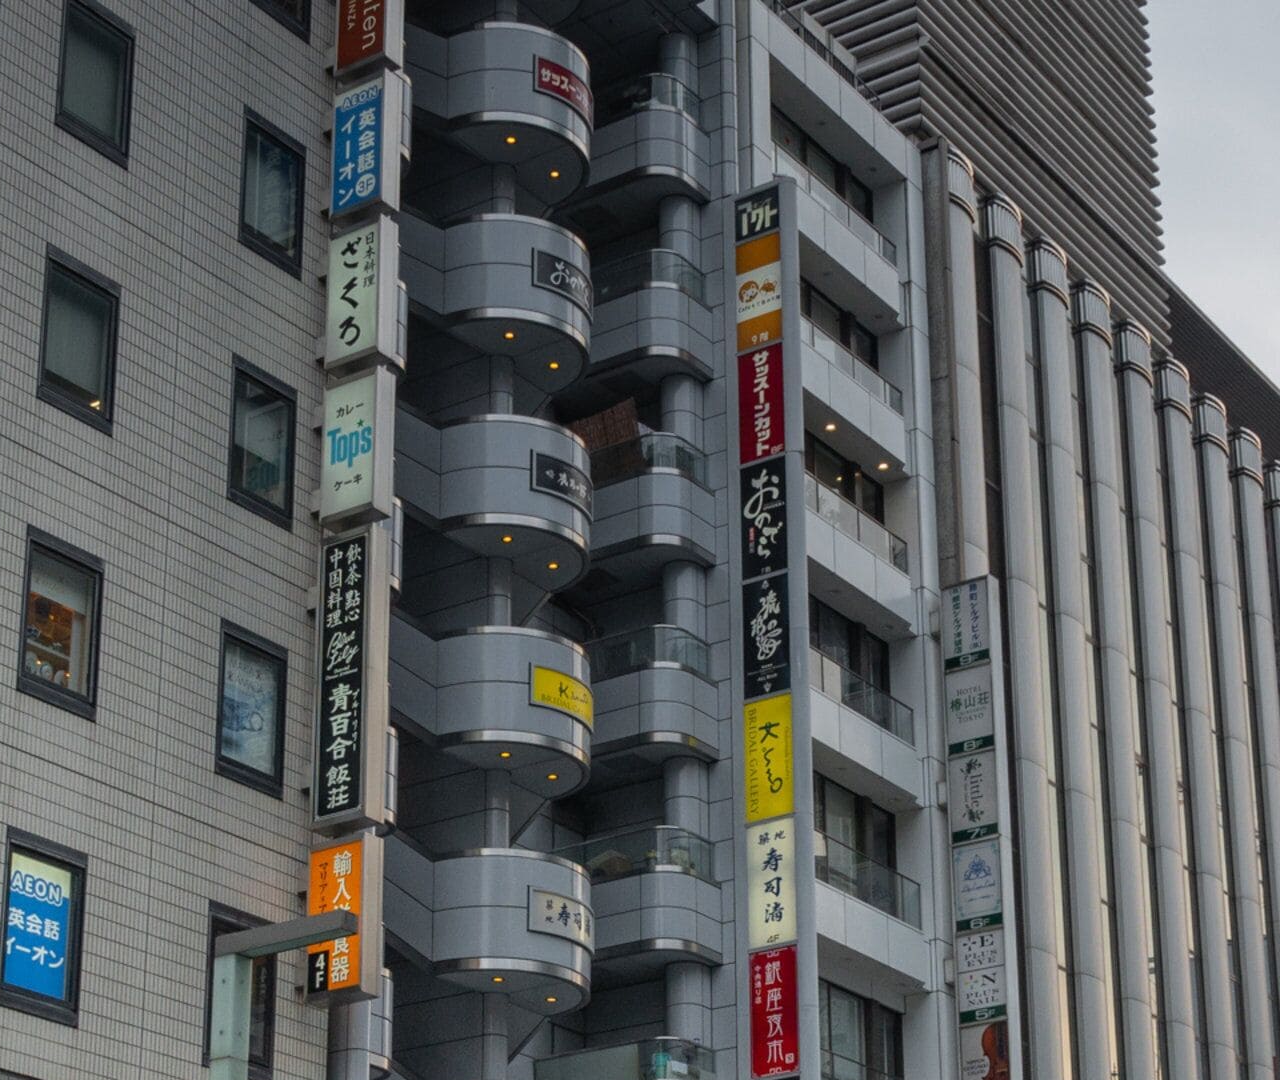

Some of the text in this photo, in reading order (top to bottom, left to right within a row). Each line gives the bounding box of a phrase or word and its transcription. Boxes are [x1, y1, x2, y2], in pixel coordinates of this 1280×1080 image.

[341, 86, 379, 111] AEON
[358, 108, 375, 173] 英会話
[338, 115, 354, 206] イーオン
[357, 176, 375, 196] 3F
[362, 231, 375, 288] 日本料理
[339, 236, 362, 346] ざくろ
[336, 402, 365, 419] カレー
[327, 424, 373, 468] Tops
[334, 473, 363, 491] ケーキ
[327, 547, 344, 629] 中国料理
[748, 708, 759, 815] BRIDAL GALLERY
[11, 871, 62, 904] AEON
[8, 906, 61, 941] 英会話
[331, 852, 352, 983] 輸入食器
[5, 939, 65, 969] イーオン
[964, 949, 998, 961] PLUS
[764, 960, 784, 1063] 銀座夜市
[966, 989, 1000, 999] PLUS
[967, 997, 999, 1007] NAIL
